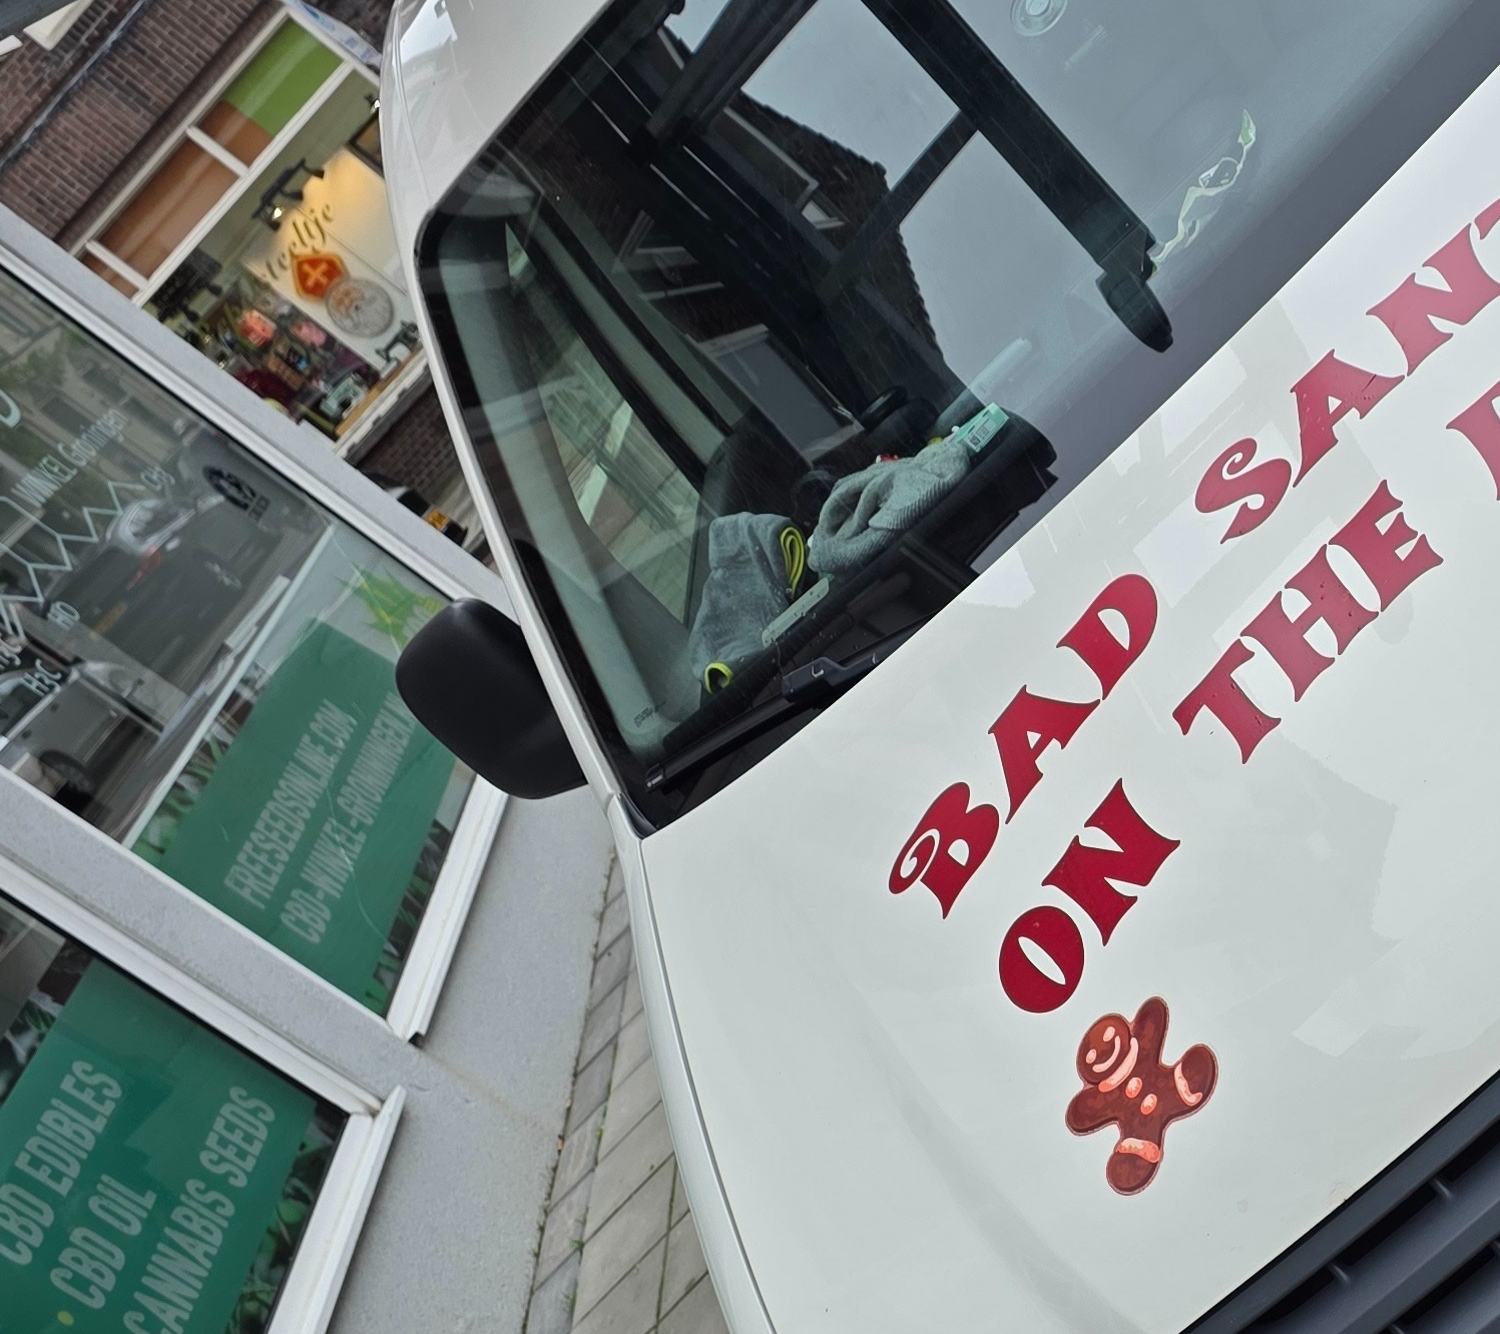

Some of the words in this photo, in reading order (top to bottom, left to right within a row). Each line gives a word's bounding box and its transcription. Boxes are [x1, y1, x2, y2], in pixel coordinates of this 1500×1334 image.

[11, 453, 77, 509] WINKEL
[57, 407, 129, 469] Groningen
[223, 697, 357, 911] FREESEEDSONLINE.COM
[887, 573, 1159, 920] BAD
[998, 779, 1180, 1014] ON
[1172, 480, 1443, 764] THE
[14, 1060, 122, 1198] EDIBLES
[199, 1085, 275, 1189] SEEDS
[0, 1182, 55, 1266] CBD
[50, 1226, 126, 1310] CBD
[88, 1174, 158, 1237] OIL
